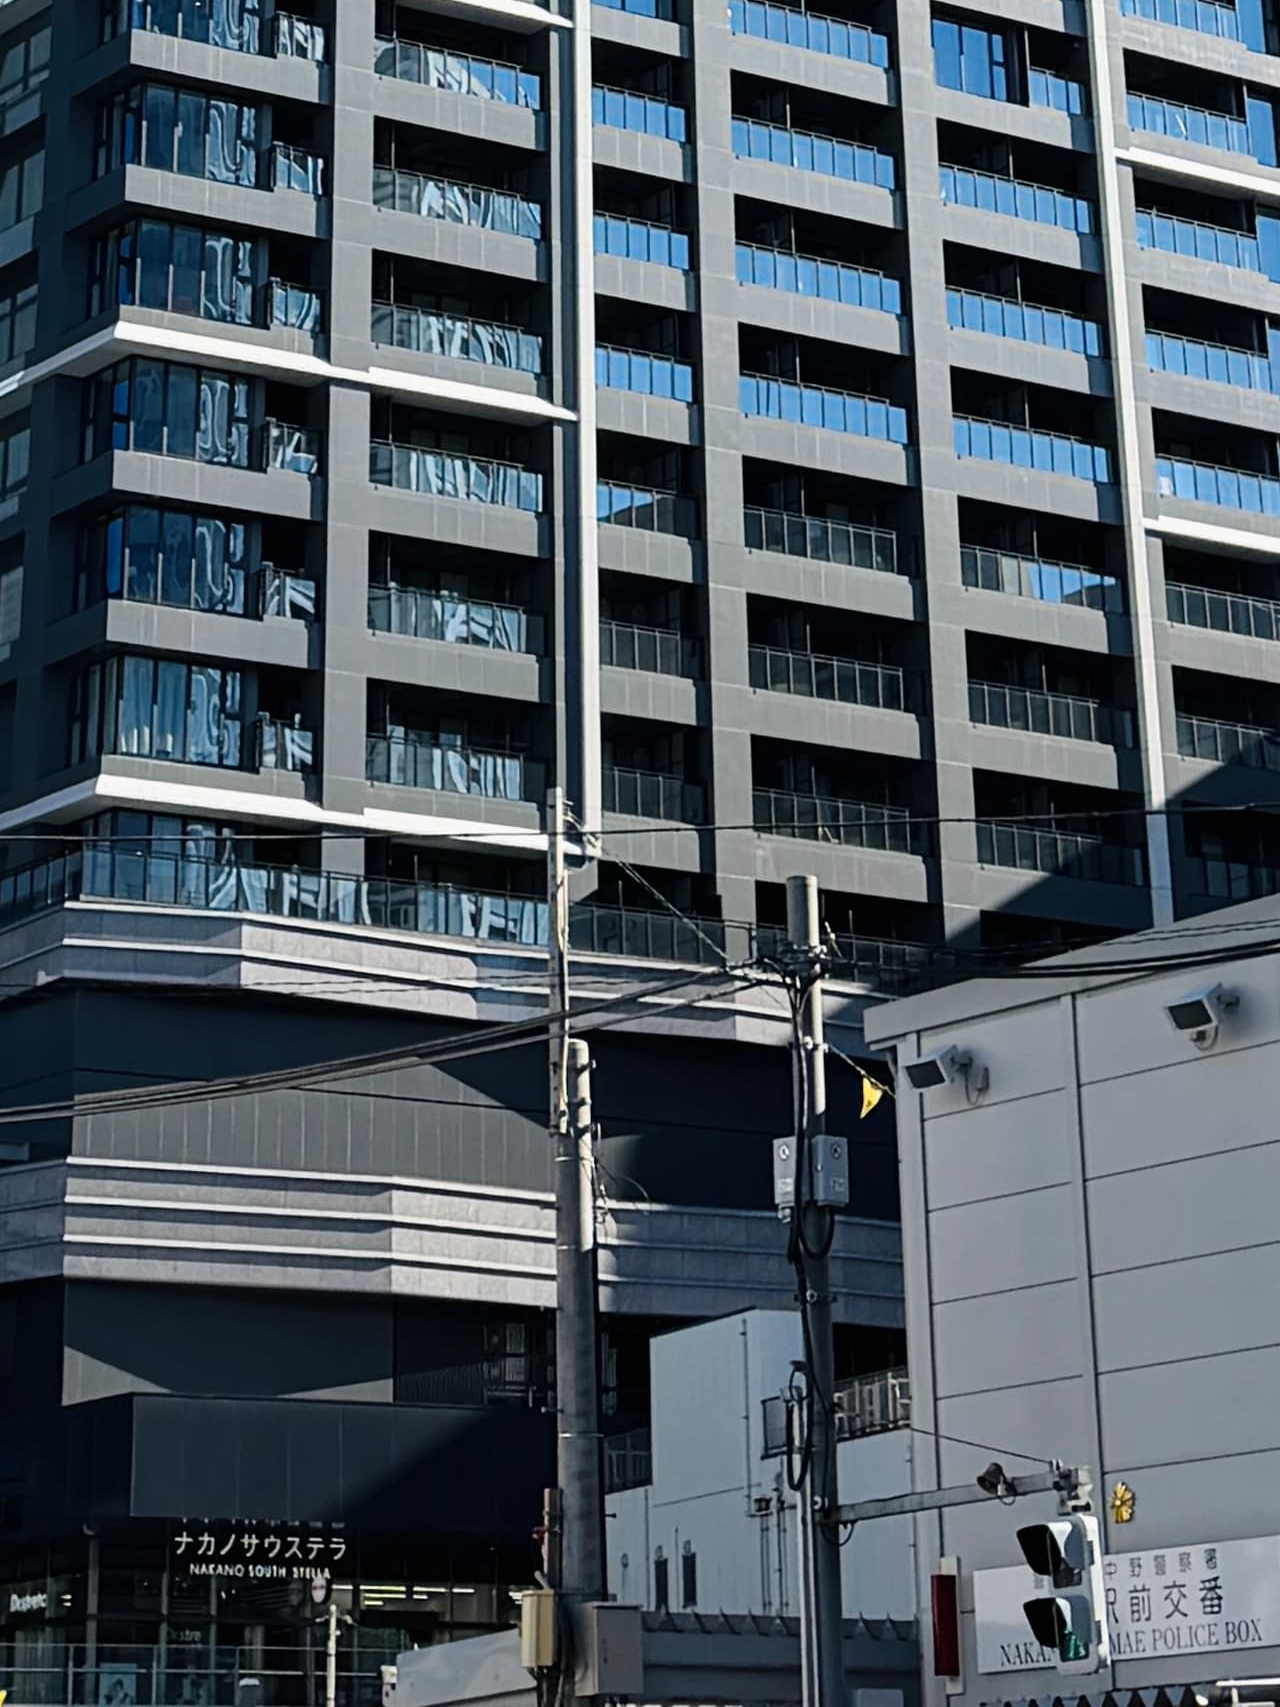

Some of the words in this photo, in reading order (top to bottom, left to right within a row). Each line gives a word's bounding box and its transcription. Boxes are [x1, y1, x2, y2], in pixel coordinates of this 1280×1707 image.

[174, 1532, 346, 1560] ナカノサウステラ
[190, 1563, 245, 1577] NAKANO
[248, 1564, 286, 1578] SOUTH
[1152, 1623, 1218, 1651] POLICE
[1224, 1619, 1263, 1644] BOX
